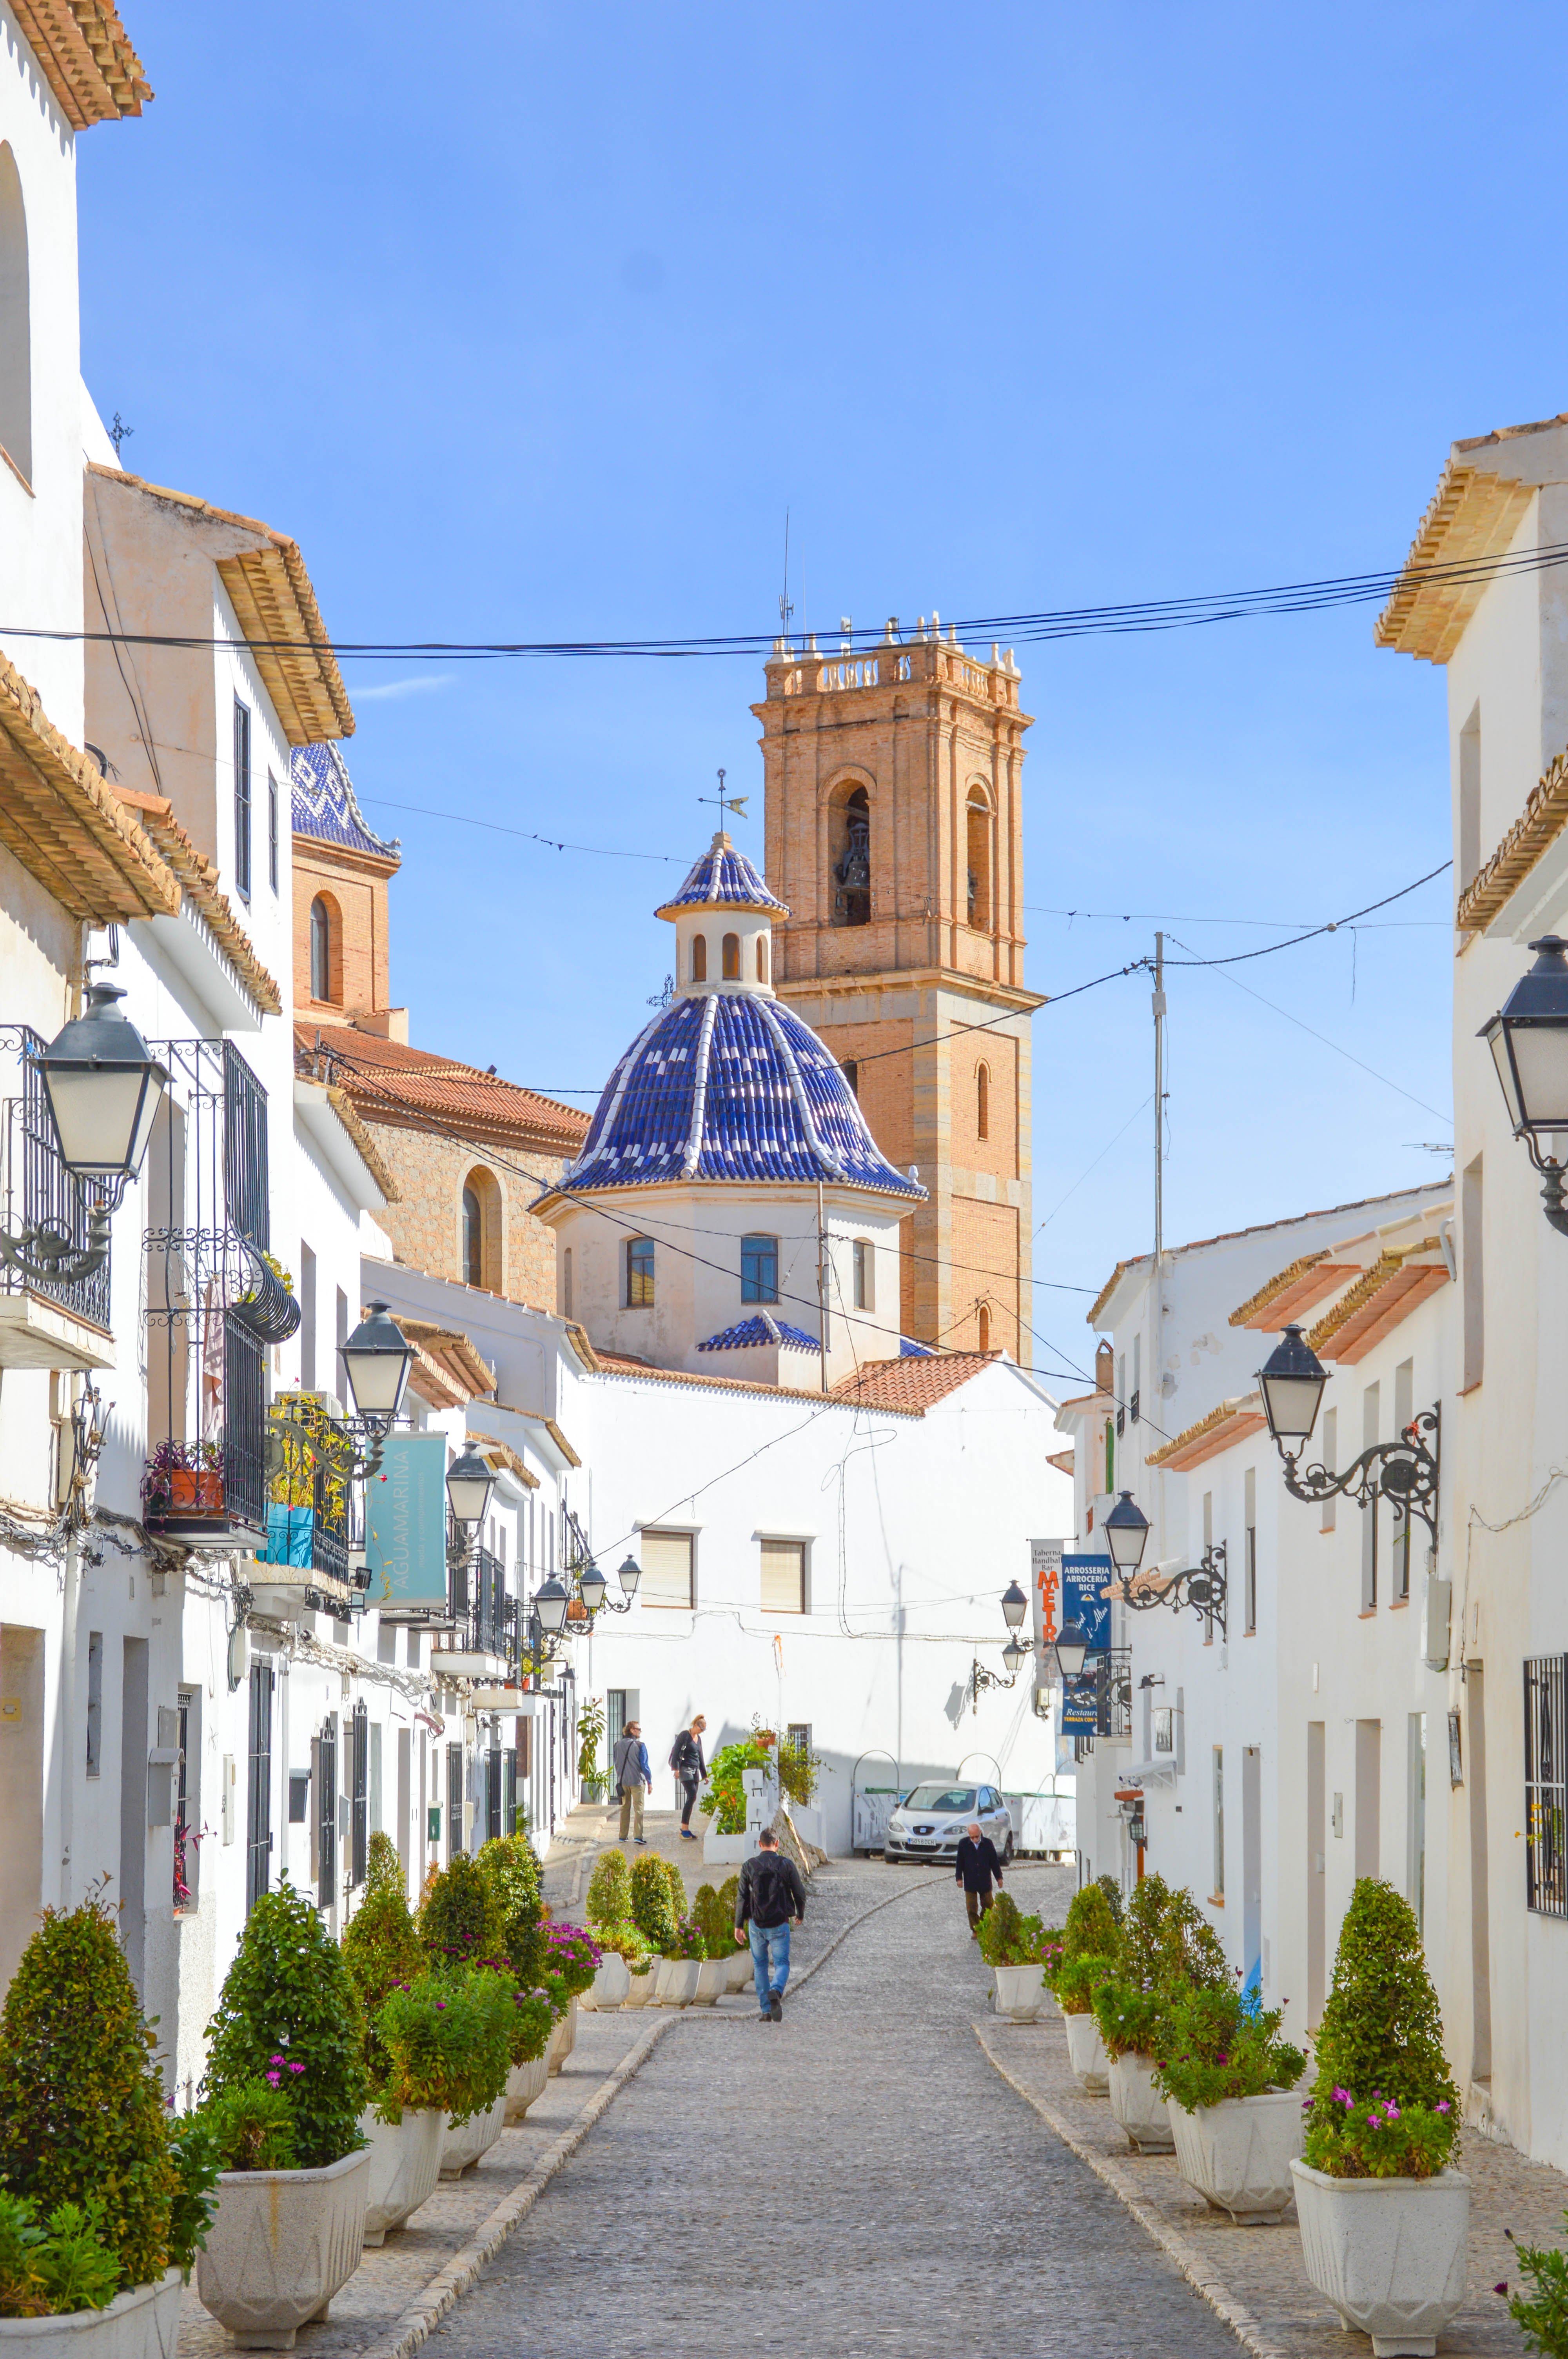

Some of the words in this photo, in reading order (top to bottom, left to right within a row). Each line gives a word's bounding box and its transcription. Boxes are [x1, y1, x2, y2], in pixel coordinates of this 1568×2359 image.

[393, 1450, 410, 1589] AGUAMARINA
[417, 1472, 426, 1534] complementos
[1066, 1574, 1108, 1583] ARROCERÍA
